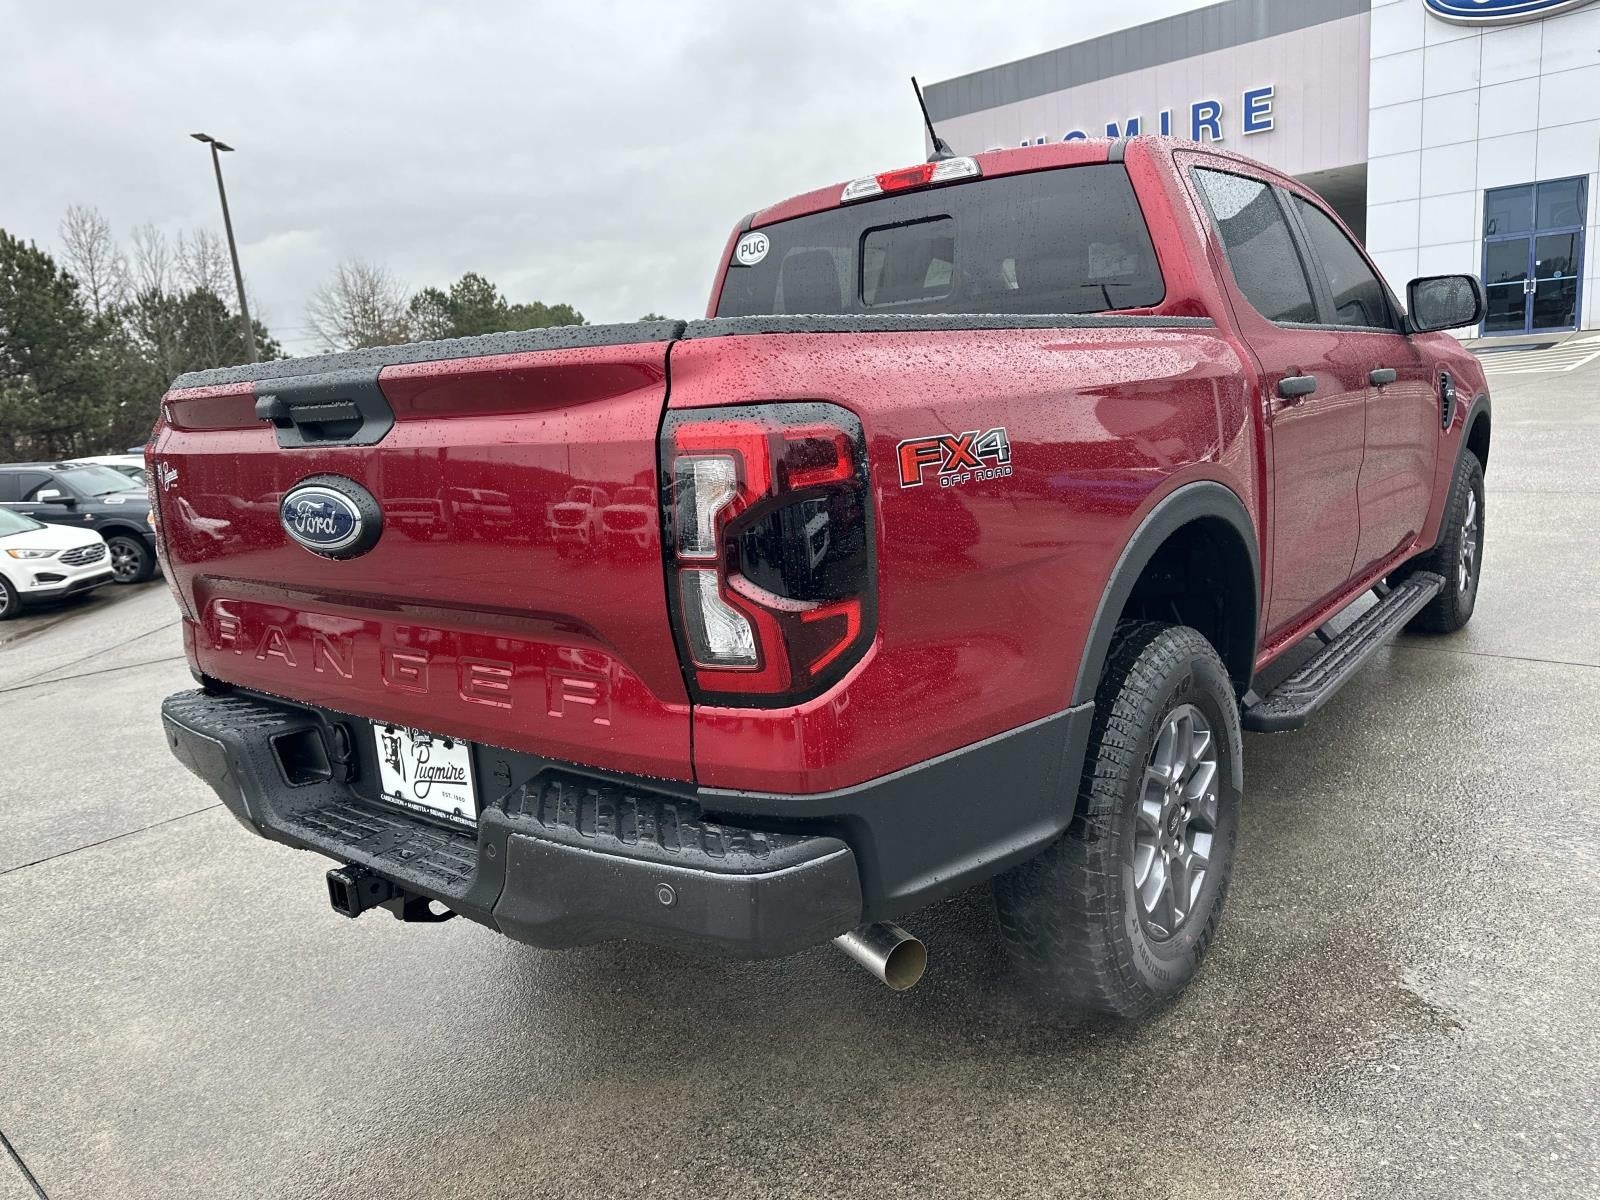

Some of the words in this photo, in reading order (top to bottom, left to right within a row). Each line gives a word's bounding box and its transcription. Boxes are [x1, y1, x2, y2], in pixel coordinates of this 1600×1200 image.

[985, 84, 1276, 151] MIRE
[741, 239, 765, 258] PUG
[896, 427, 1012, 489] FX4
[939, 472, 972, 488] OFF
[975, 465, 1014, 482] ROAD
[294, 500, 338, 535] Ford
[214, 612, 613, 727] RANGER
[411, 743, 468, 800] Pugmire
